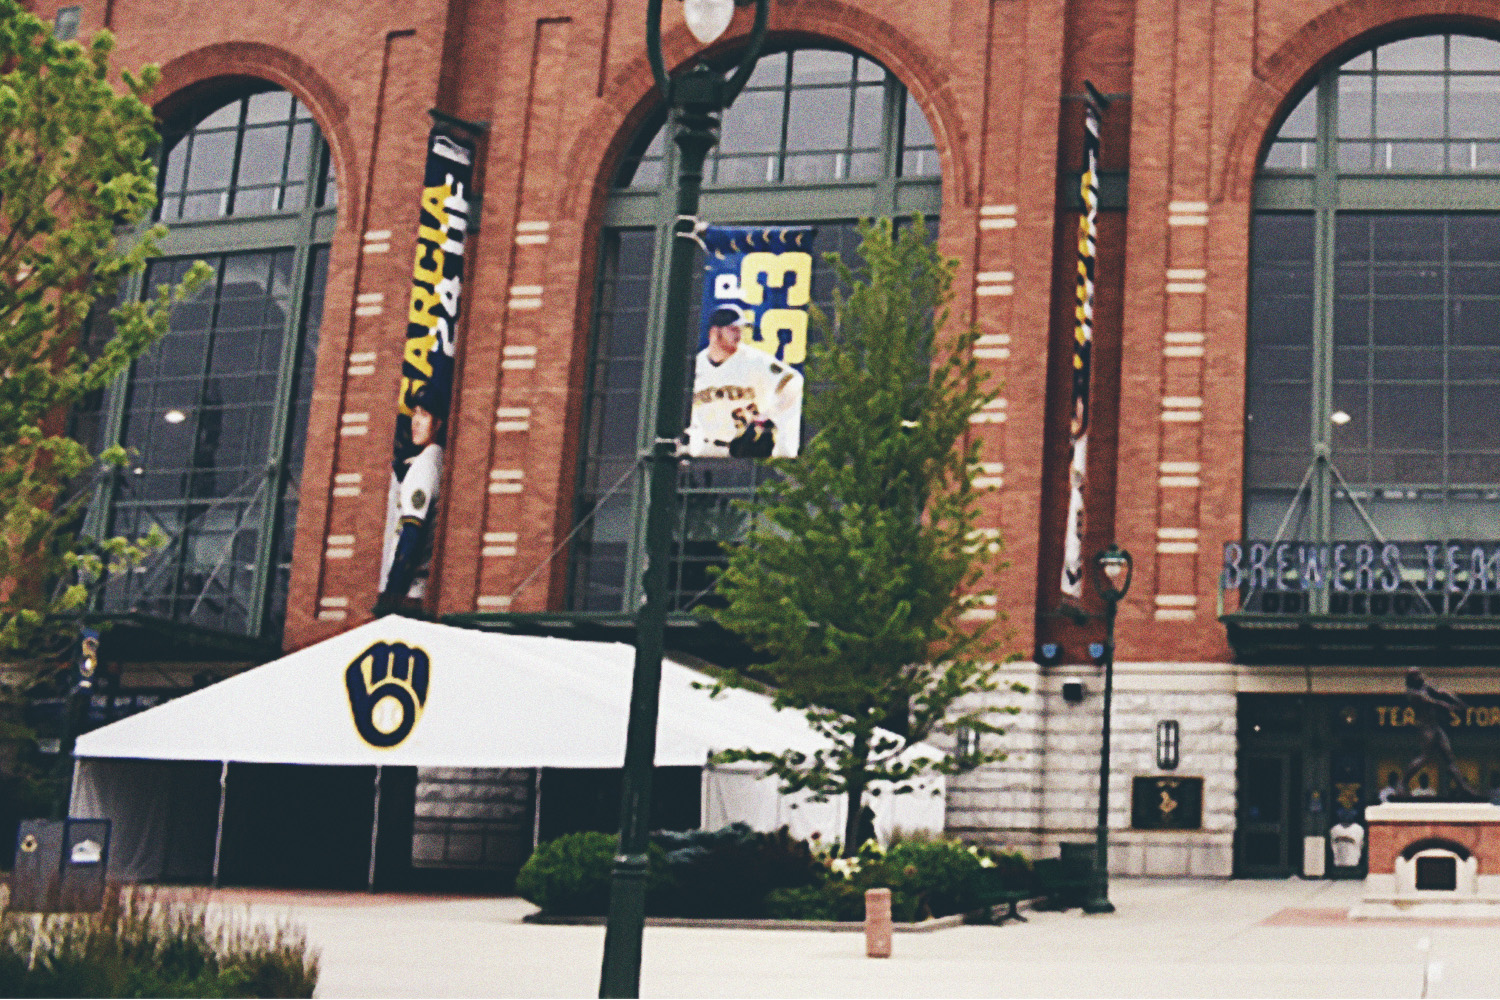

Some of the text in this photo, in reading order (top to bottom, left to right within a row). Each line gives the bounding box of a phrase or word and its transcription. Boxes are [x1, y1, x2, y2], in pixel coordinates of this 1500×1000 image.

[398, 179, 452, 418] GARCIA
[428, 275, 461, 358] 24
[741, 251, 812, 365] 53
[1225, 543, 1400, 592] BREWERS
[1376, 705, 1417, 727] TEA
